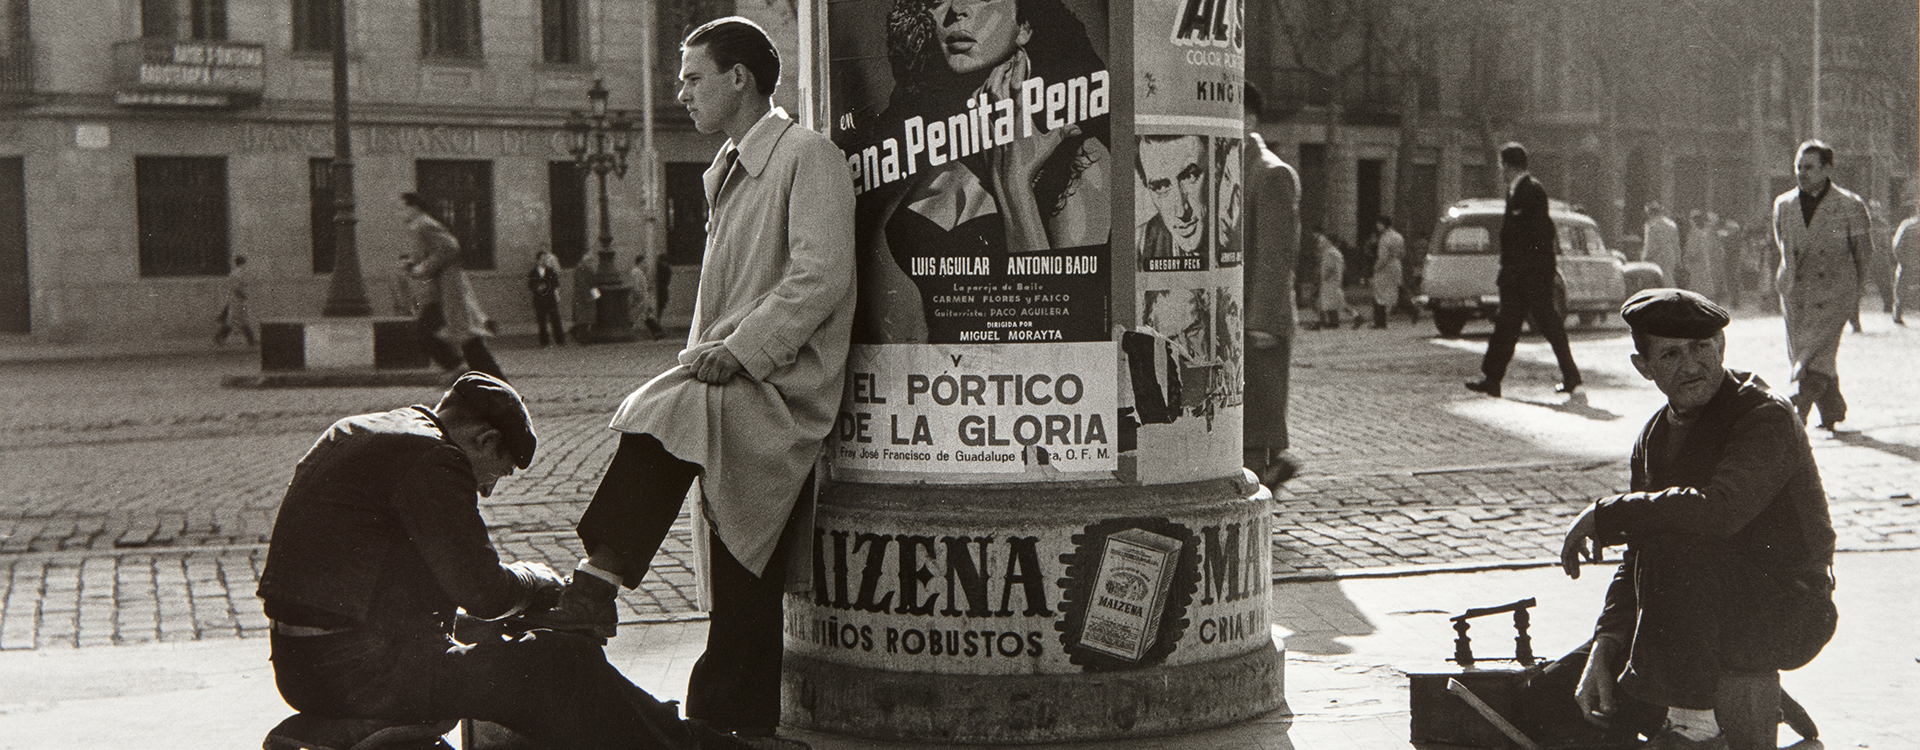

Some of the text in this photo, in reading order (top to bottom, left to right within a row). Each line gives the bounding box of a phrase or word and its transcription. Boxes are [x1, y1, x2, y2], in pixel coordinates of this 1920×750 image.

[1186, 49, 1222, 66] COLOR
[1197, 81, 1234, 103] KING
[840, 112, 856, 131] en
[843, 69, 1110, 196] ena, Penita Pena
[911, 256, 990, 276] LUIS AGUILAR
[1007, 255, 1098, 276] ANTONIO BADU
[1149, 259, 1201, 271] GREGORY PECK
[953, 283, 1044, 294] La pareja de Baile
[933, 294, 1070, 305] CARMEN FLORES y FAICO
[990, 308, 1017, 317] PACO
[1021, 307, 1070, 316] AGUILERA
[986, 321, 1018, 329] DIRIGIDA
[959, 330, 1063, 341] MIGUEL MORAYTA
[854, 371, 1084, 406] EL PÓRTICO
[840, 411, 1108, 447] DE LA GLORIA
[840, 446, 857, 460] Fray
[860, 448, 879, 460] José
[883, 449, 931, 461] Francisco
[936, 450, 950, 461] de
[955, 450, 1016, 463] Guadalupe
[1065, 448, 1078, 460] O.
[1081, 448, 1092, 460] F.
[1097, 448, 1110, 460] M.
[1098, 596, 1144, 618] MAIZENA
[1200, 611, 1245, 644] CRIA
[886, 627, 1044, 659] ROBUSTOS
